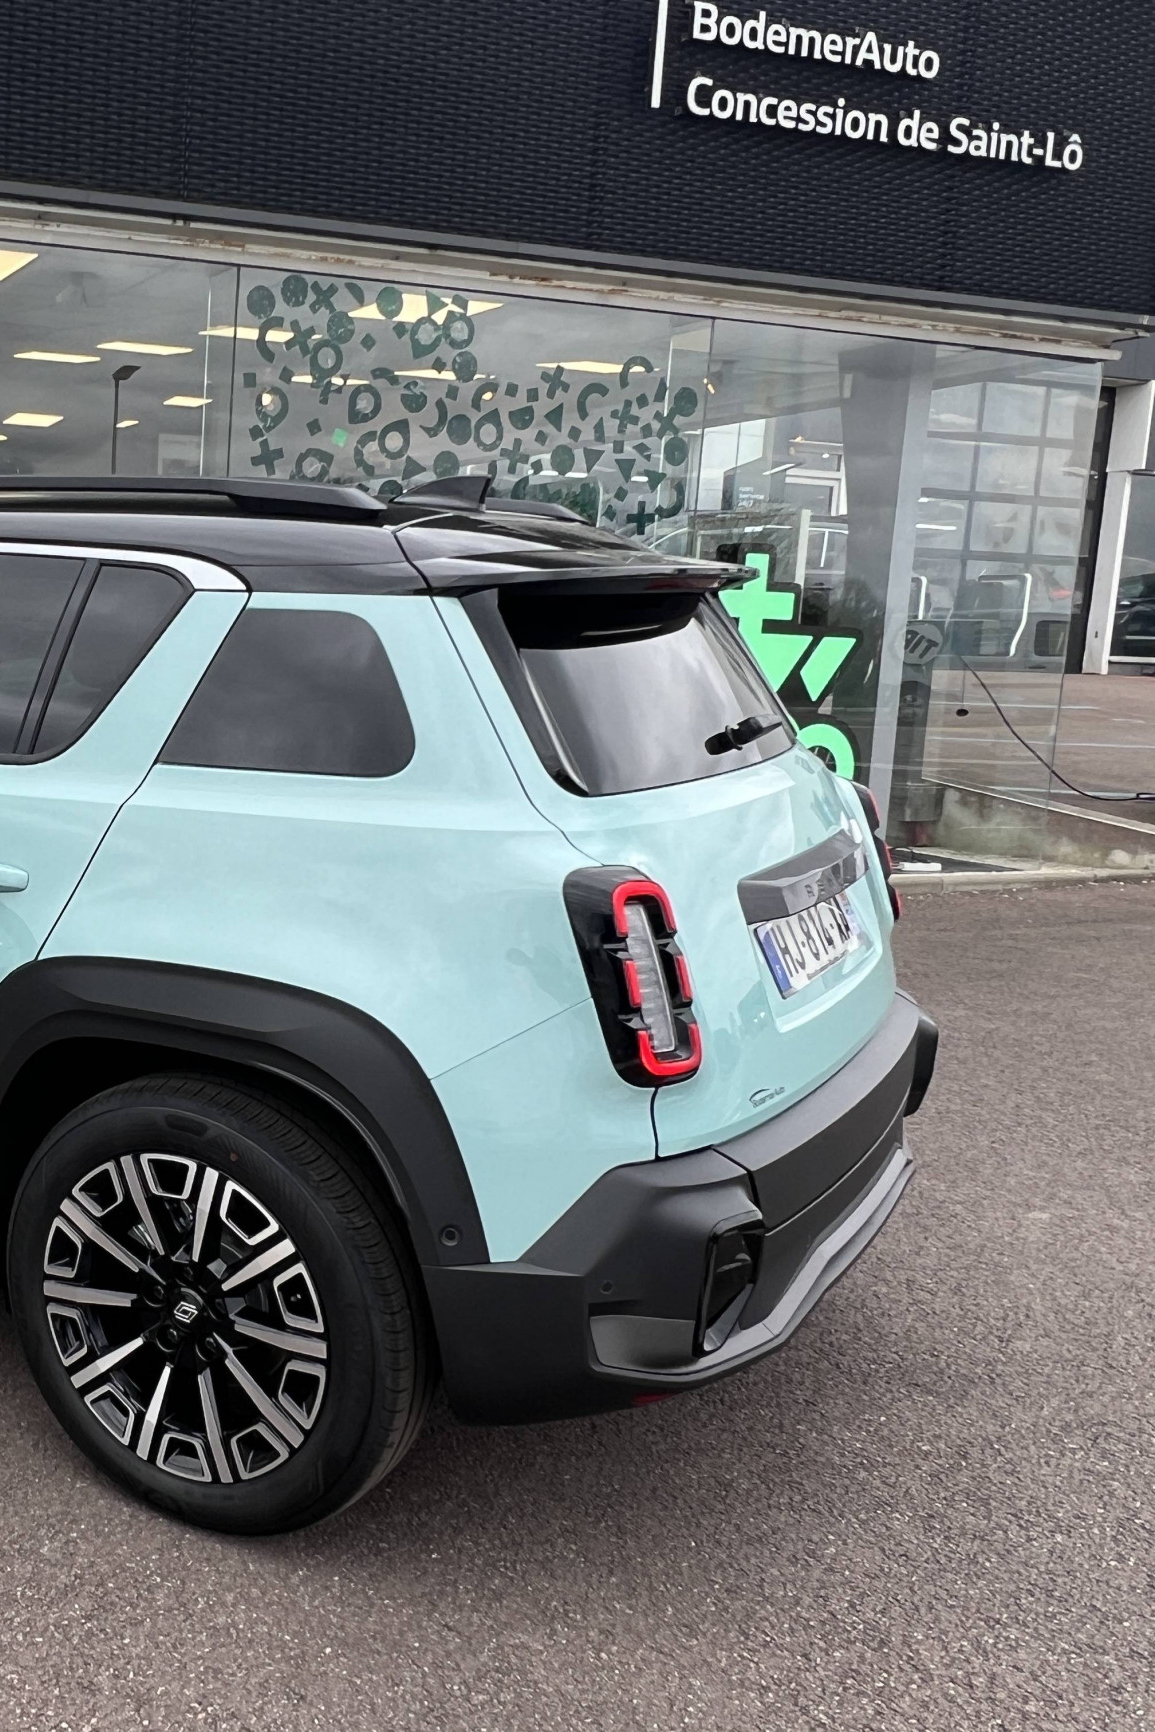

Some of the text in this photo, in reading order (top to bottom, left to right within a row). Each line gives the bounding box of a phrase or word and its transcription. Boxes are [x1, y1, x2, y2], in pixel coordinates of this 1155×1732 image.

[692, 1, 940, 79] BodemerAuto
[687, 75, 1083, 170] Concession de Saint-Lô
